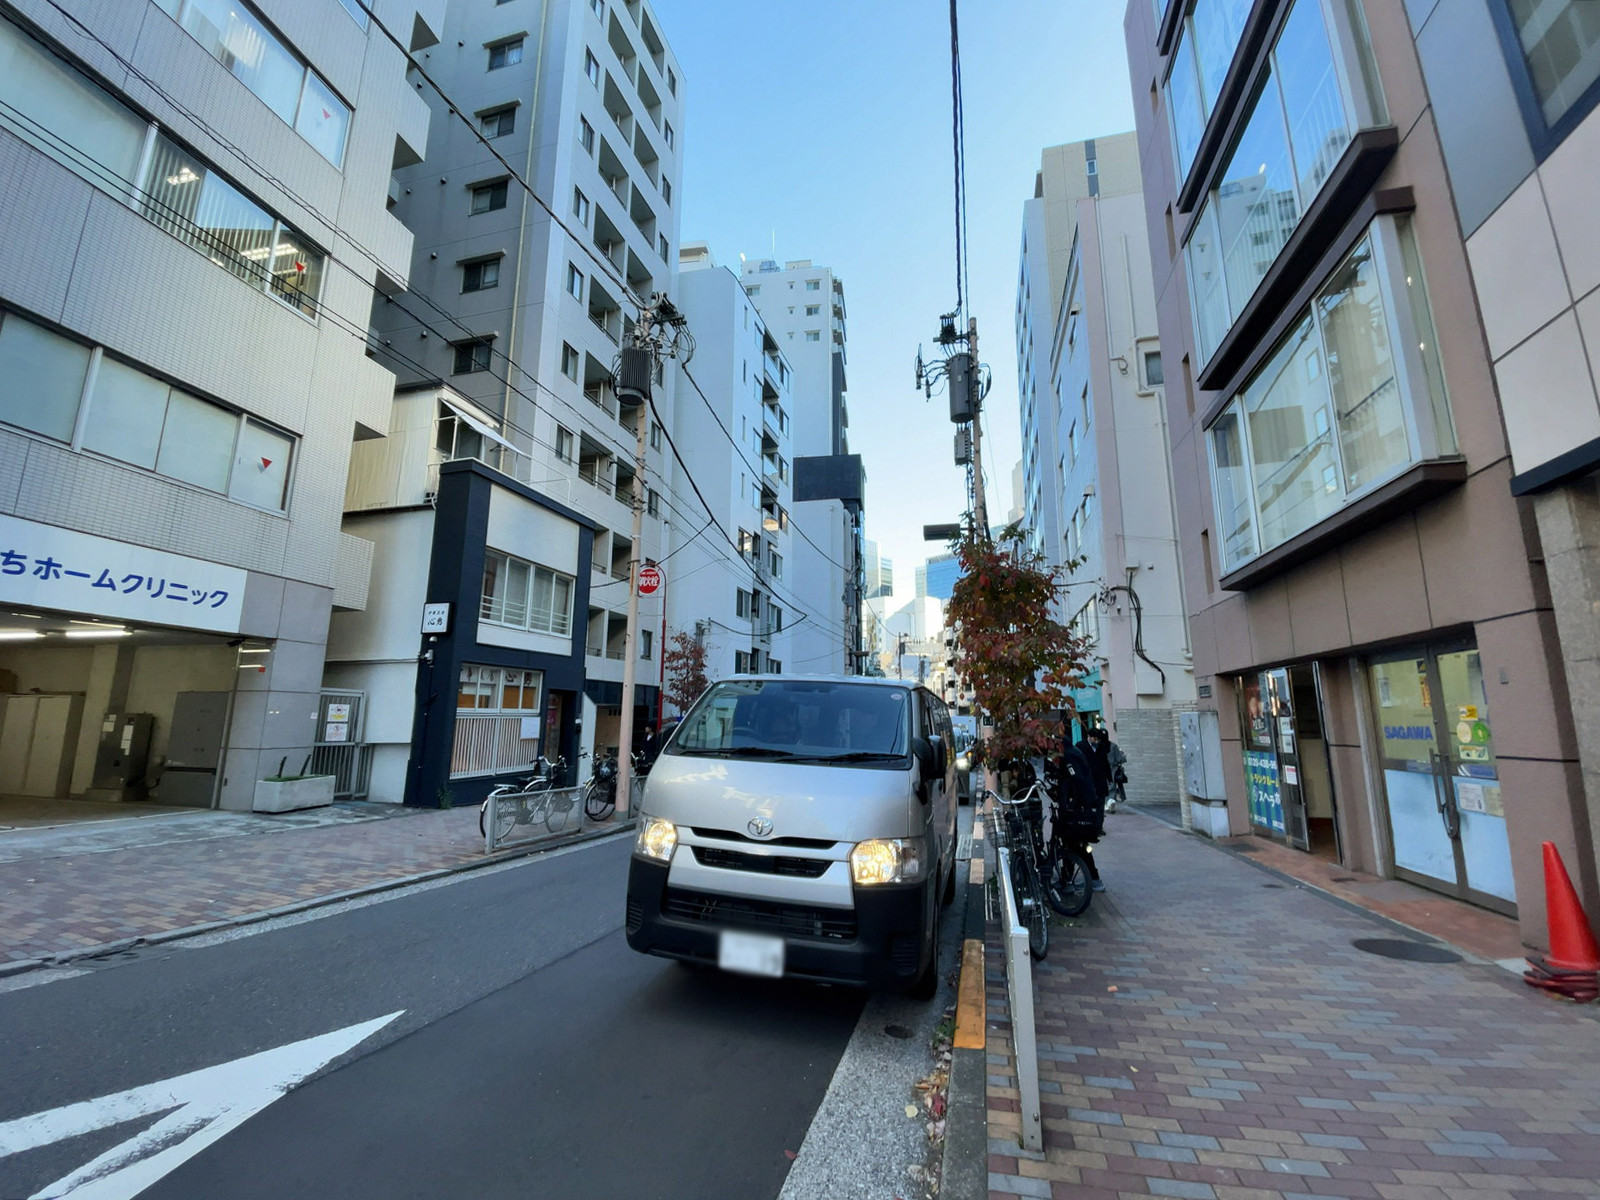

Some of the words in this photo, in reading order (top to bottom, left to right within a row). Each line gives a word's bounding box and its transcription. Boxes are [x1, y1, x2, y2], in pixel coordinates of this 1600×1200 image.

[1, 549, 229, 608] ちホームクリニック
[1384, 725, 1434, 741] SAGAWA
